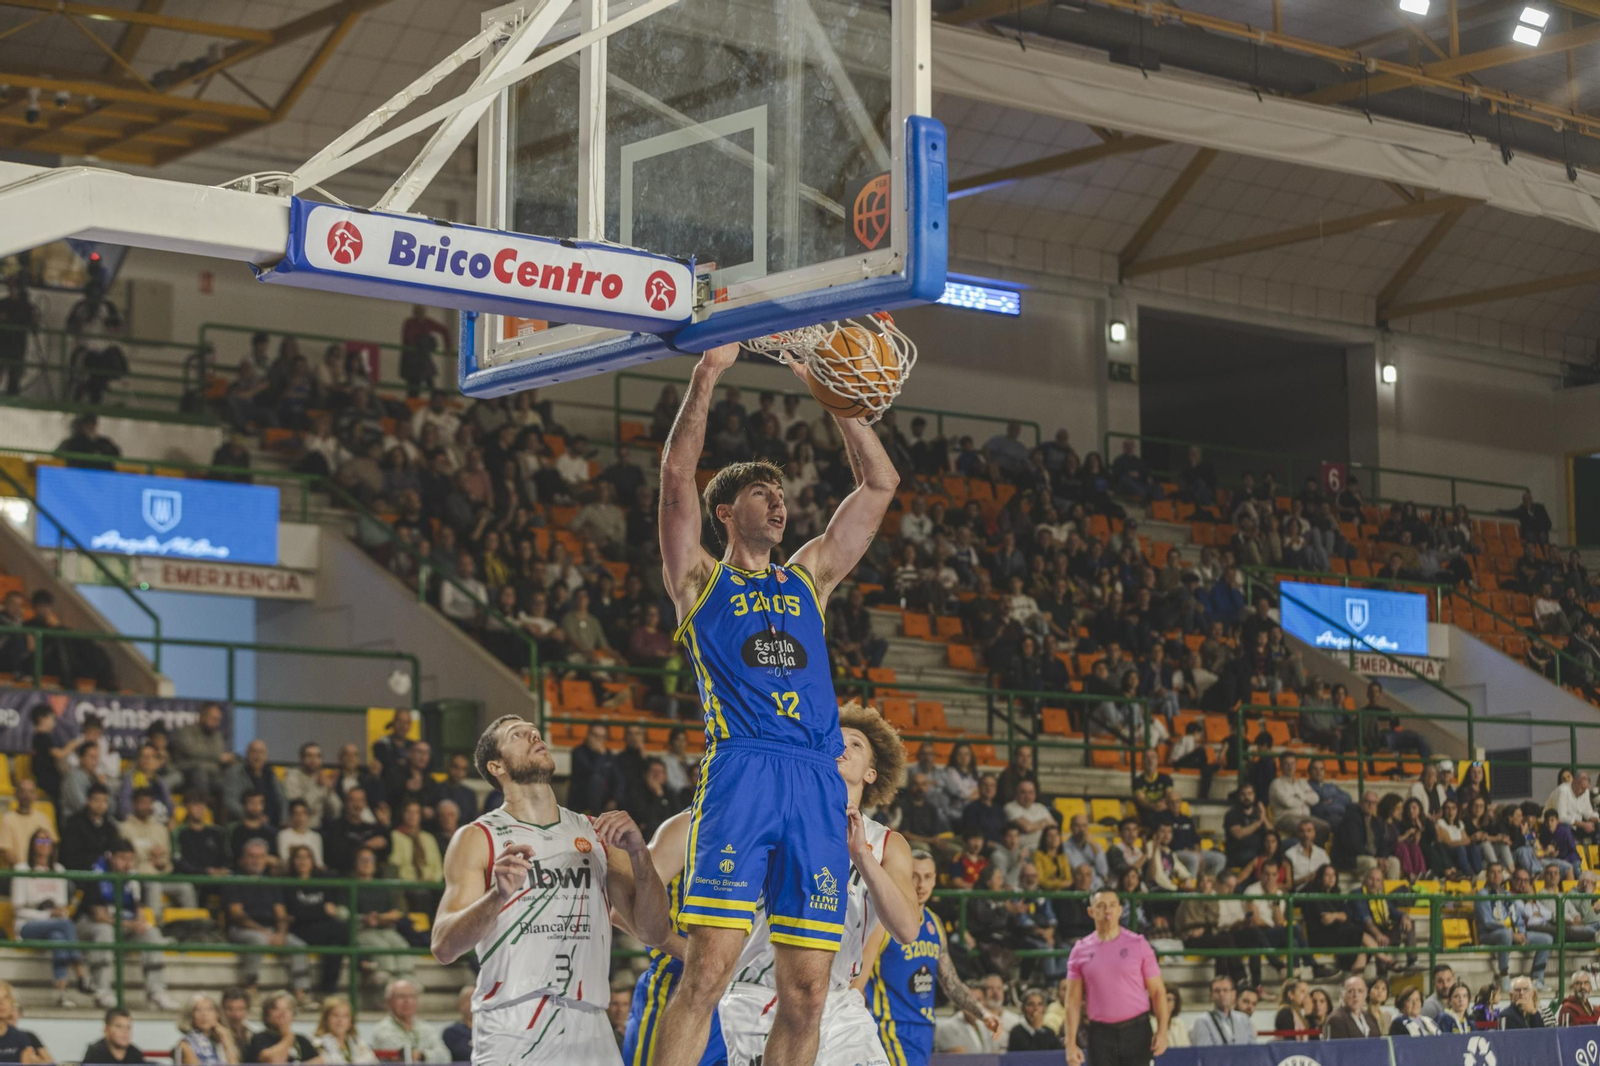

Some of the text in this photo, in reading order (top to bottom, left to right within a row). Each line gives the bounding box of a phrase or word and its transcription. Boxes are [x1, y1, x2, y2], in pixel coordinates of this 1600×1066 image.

[388, 230, 623, 299] BricoCentro
[1329, 467, 1340, 492] 6
[161, 563, 300, 593] EMERXENCIA
[754, 638, 795, 653] Estrlla
[757, 650, 796, 667] Galiia
[771, 691, 800, 720] 12
[518, 858, 591, 890] ibwi
[720, 860, 735, 873] MG
[695, 876, 721, 886] Blendio
[555, 954, 570, 982] 3
